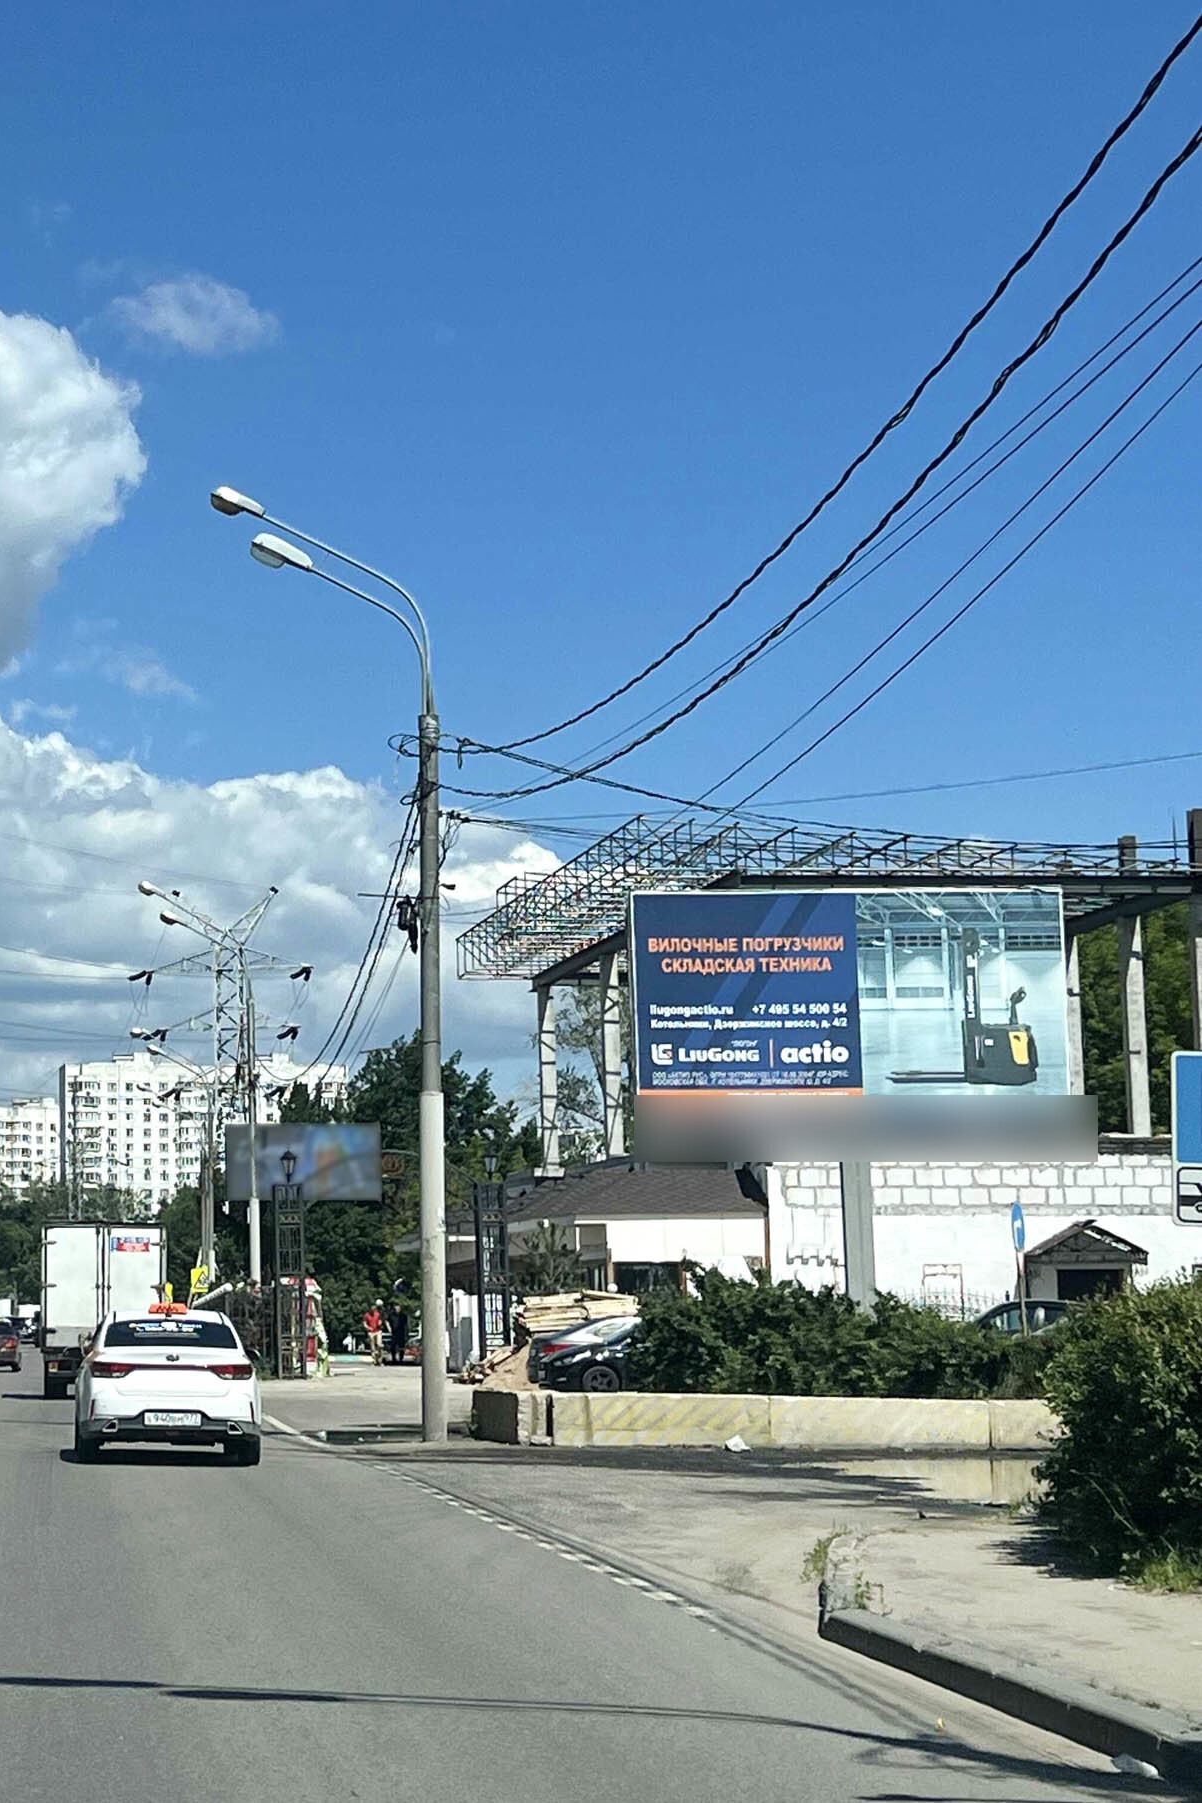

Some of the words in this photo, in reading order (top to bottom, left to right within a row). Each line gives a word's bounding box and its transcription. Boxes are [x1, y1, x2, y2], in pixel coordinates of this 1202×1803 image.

[648, 937, 739, 953] ВИЛОЧНЫЕ
[742, 936, 845, 952] ПОГРУЗЧИКИ
[661, 957, 756, 975] СКЛАДСКАЯ
[759, 956, 833, 972] ТЕХНИКА
[752, 1003, 767, 1015] +7
[768, 1003, 790, 1015] 495
[792, 1003, 807, 1014] 54
[809, 1002, 830, 1014] 500
[832, 1002, 848, 1014] 54
[780, 1040, 850, 1063] actio
